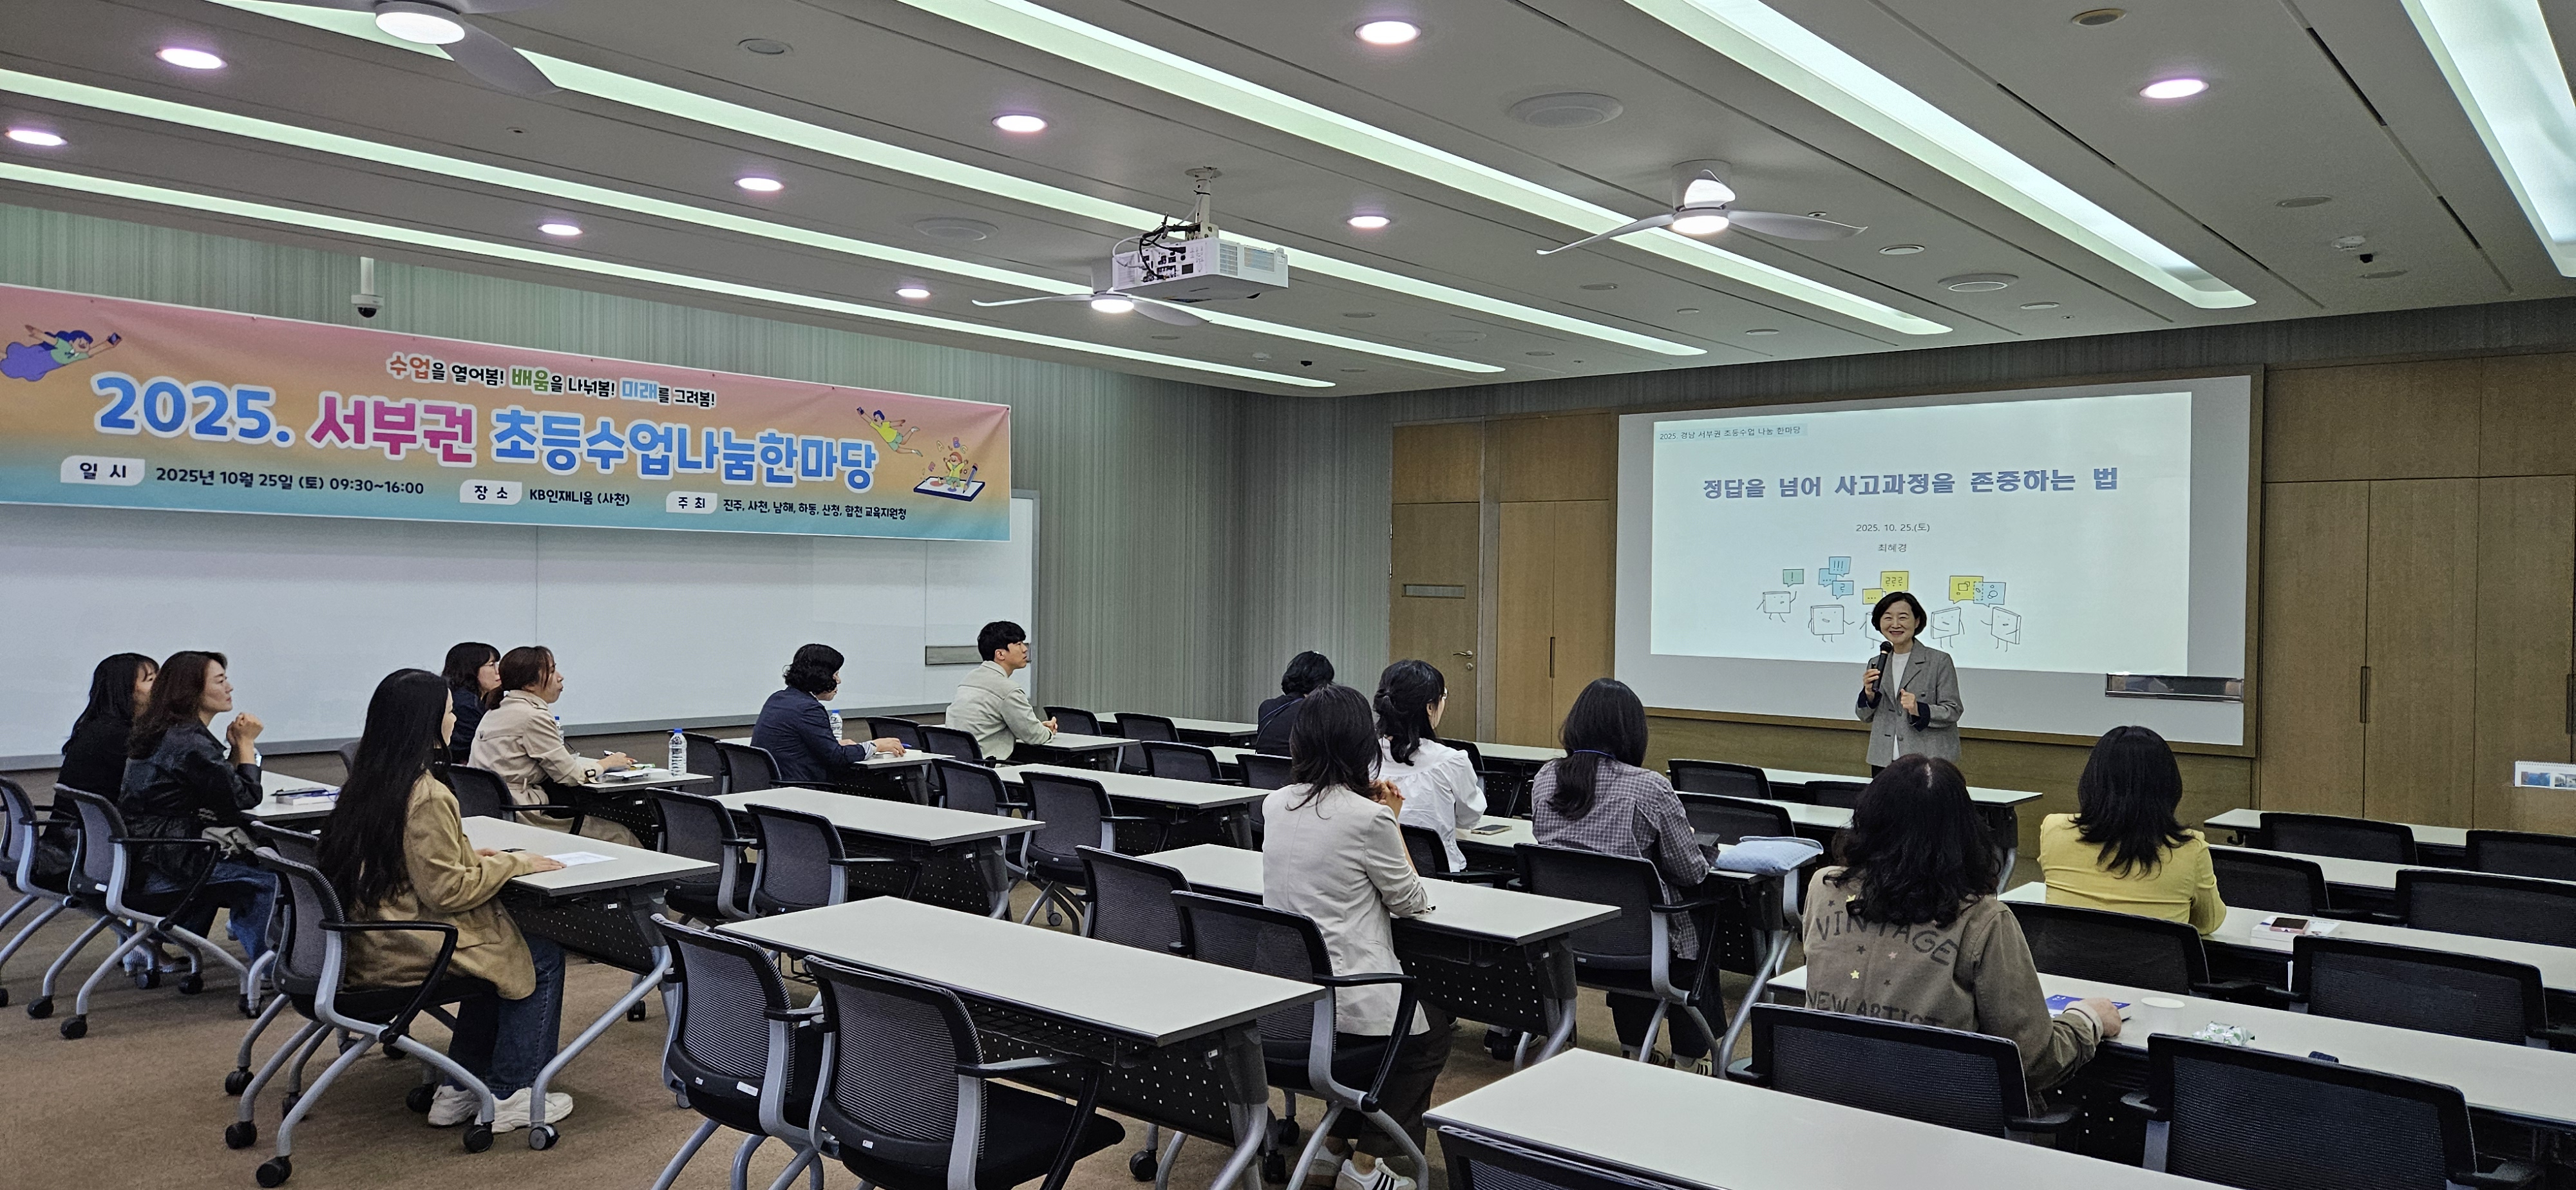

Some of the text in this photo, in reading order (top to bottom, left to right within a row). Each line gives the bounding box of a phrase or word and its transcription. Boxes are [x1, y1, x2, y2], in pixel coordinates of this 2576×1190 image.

[390, 355, 715, 408] 수업을 열어봄! 배움을 나눠봄! 미래를 그려봄!
[96, 376, 877, 490] 2025. 서부권 초등수업나눔한마당
[1698, 430, 1721, 439] 서부권
[1777, 426, 1801, 435] 한마당
[79, 462, 127, 480] 일 시
[156, 467, 424, 494] 2025년 10월 25일 (토) 09:30~16:00
[1703, 467, 2118, 499] 정답을 넘어 사고과정을 존중하는 법
[474, 485, 508, 500] 장 소
[529, 489, 630, 507] KB인재니움 (사천)
[678, 496, 705, 509] 주 최
[723, 499, 907, 520] 진주, 사천, 남해, 하동, 산청, 합천 교육지원청
[1900, 523, 1930, 533] 25.(토)
[1878, 543, 1907, 552] 최혜경
